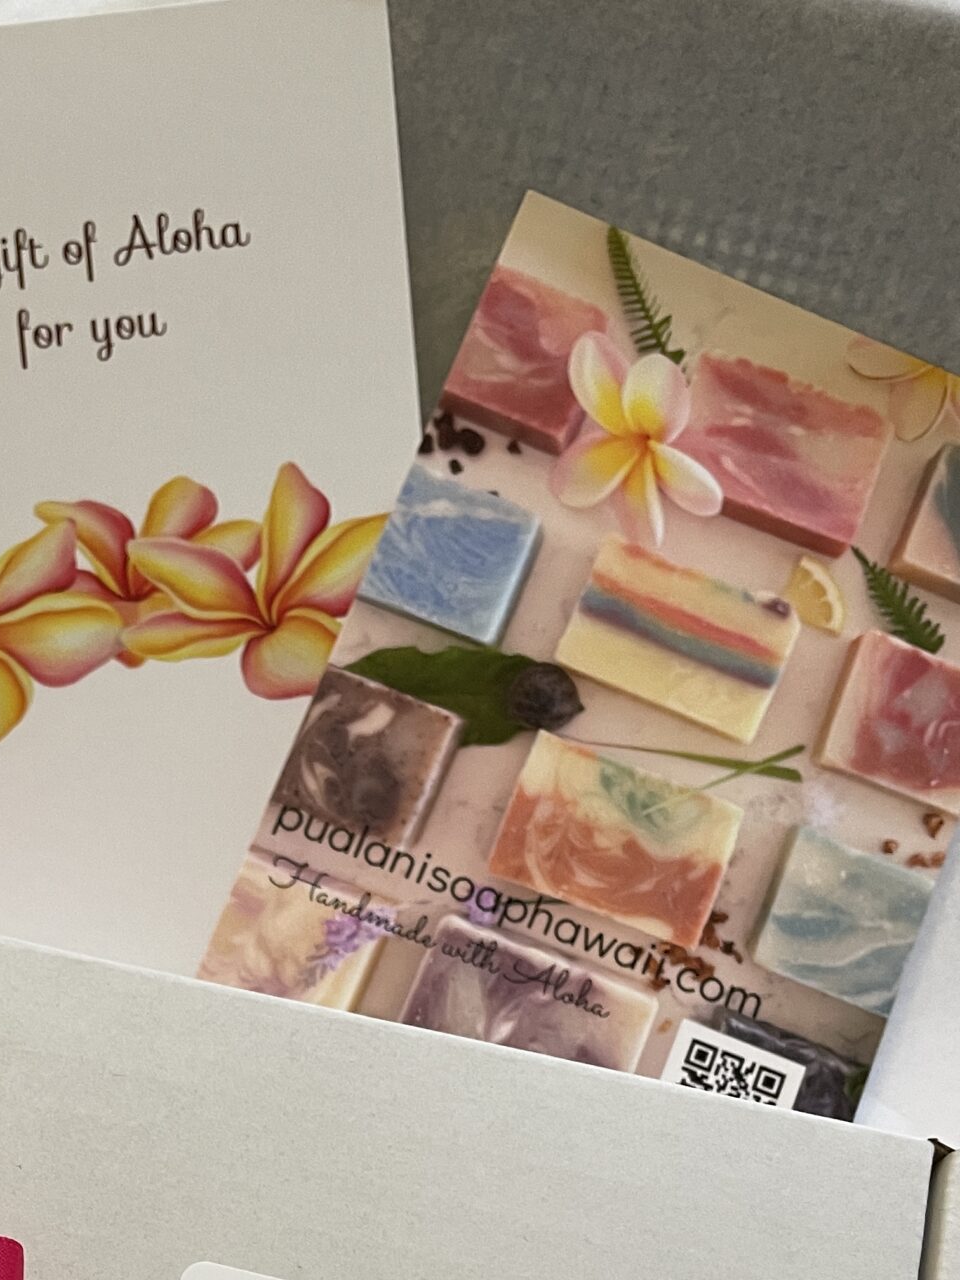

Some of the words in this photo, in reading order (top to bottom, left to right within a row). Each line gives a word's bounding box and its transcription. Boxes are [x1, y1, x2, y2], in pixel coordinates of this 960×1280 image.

[62, 220, 96, 282] of
[113, 208, 251, 267] Aloha
[18, 308, 73, 370] for
[90, 311, 167, 362] you
[268, 856, 437, 949] Handmade
[441, 940, 502, 975] with
[503, 959, 610, 1020] Aloha
[271, 804, 762, 1020] pualanisoaphawaii.com
